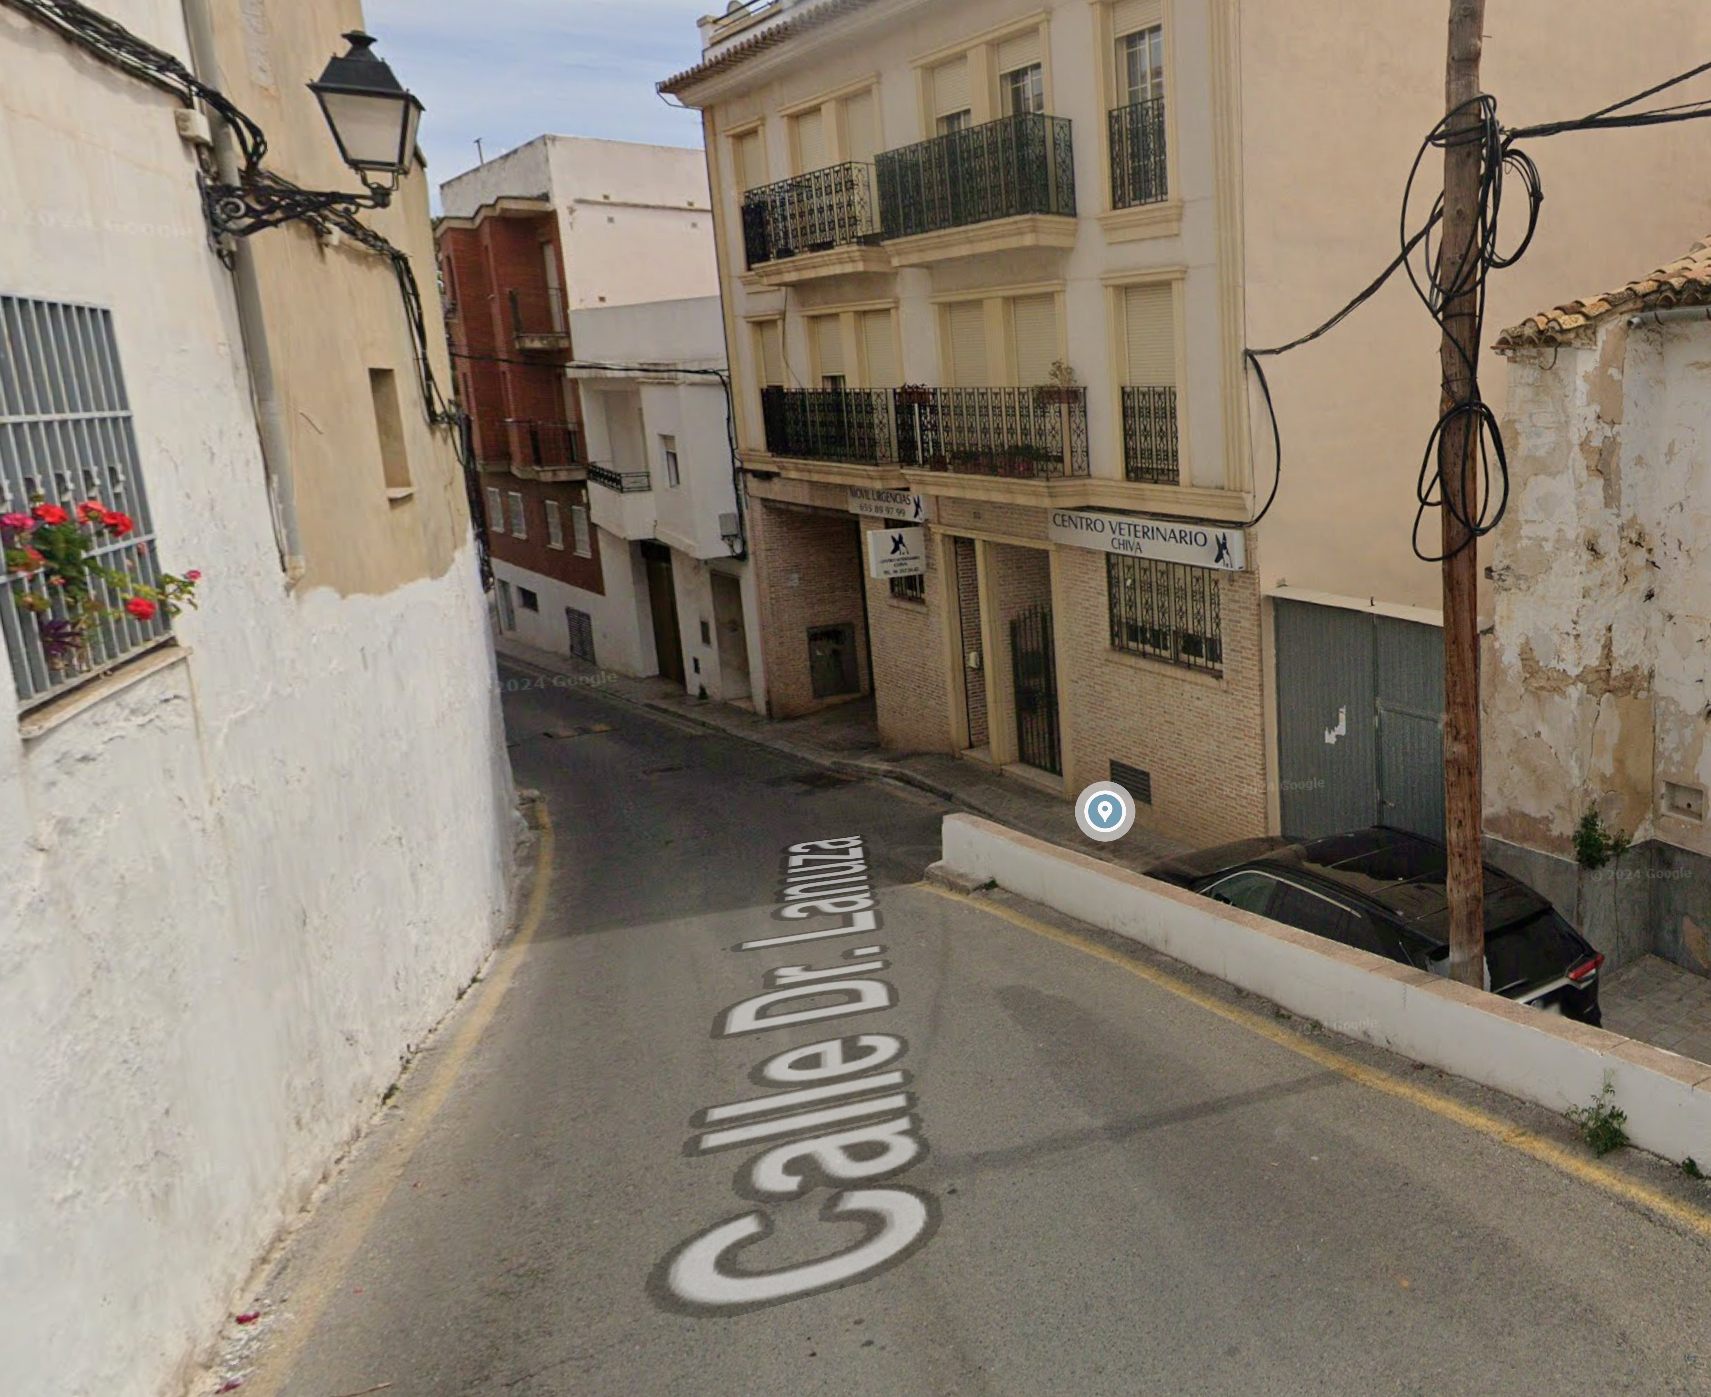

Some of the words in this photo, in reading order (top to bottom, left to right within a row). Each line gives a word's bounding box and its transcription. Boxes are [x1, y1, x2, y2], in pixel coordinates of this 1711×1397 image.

[872, 490, 911, 505] URGENCIAS
[1052, 512, 1105, 533] CENTRO
[1108, 520, 1208, 547] VETERINARIO
[1111, 537, 1143, 554] CHIVA
